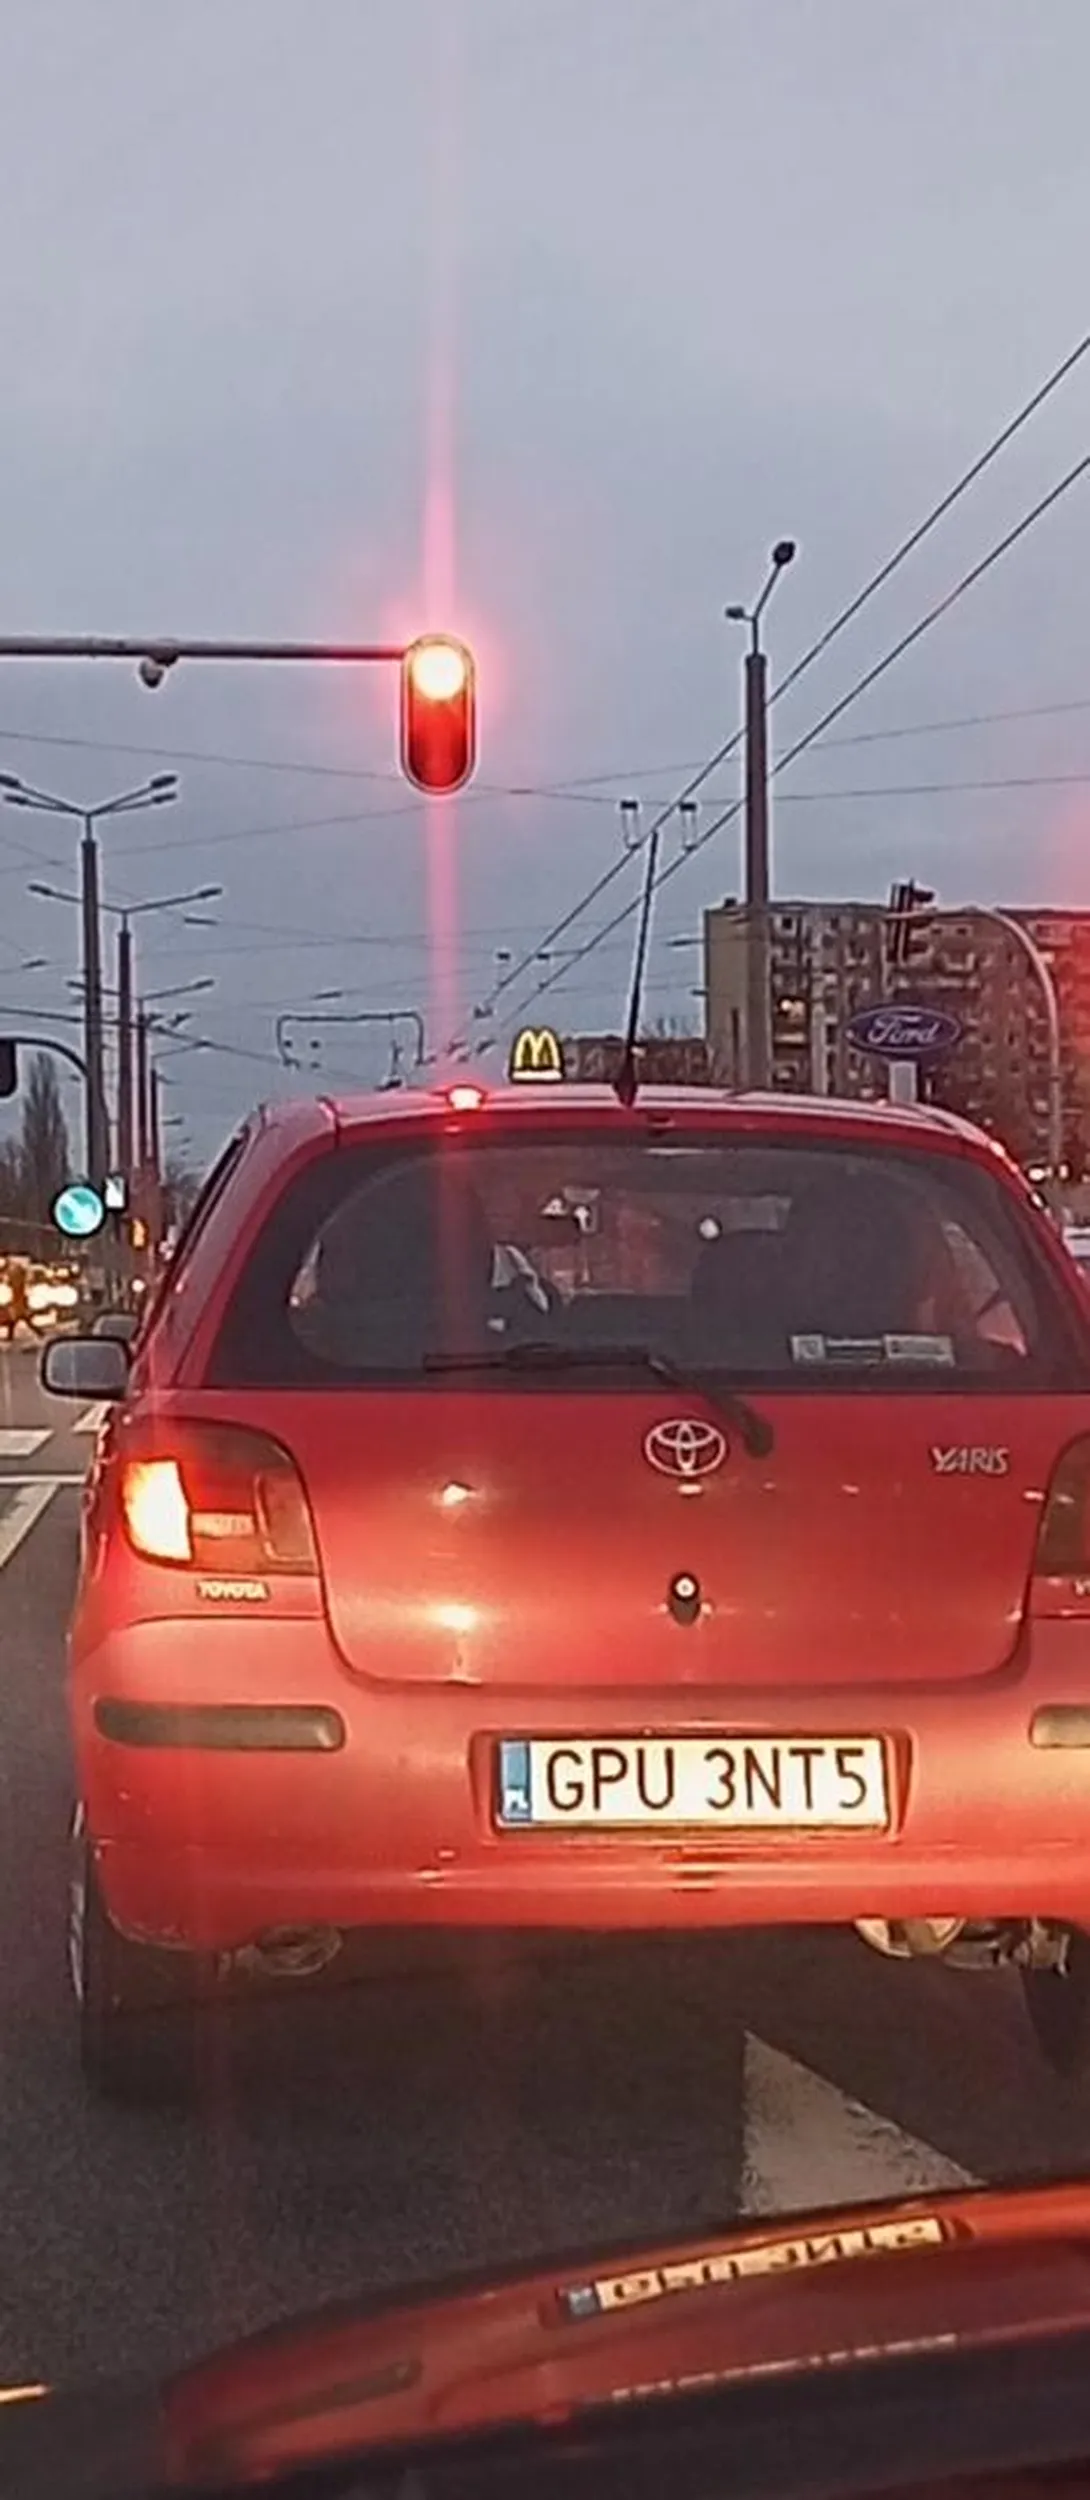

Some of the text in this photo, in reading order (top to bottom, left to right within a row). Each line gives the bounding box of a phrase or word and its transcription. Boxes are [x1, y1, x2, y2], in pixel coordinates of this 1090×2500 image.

[868, 1014, 940, 1043] Ford
[932, 1447, 1010, 1474] YARIS
[199, 1581, 268, 1599] TOYOTA
[546, 1748, 867, 1811] GPU 3NT5
